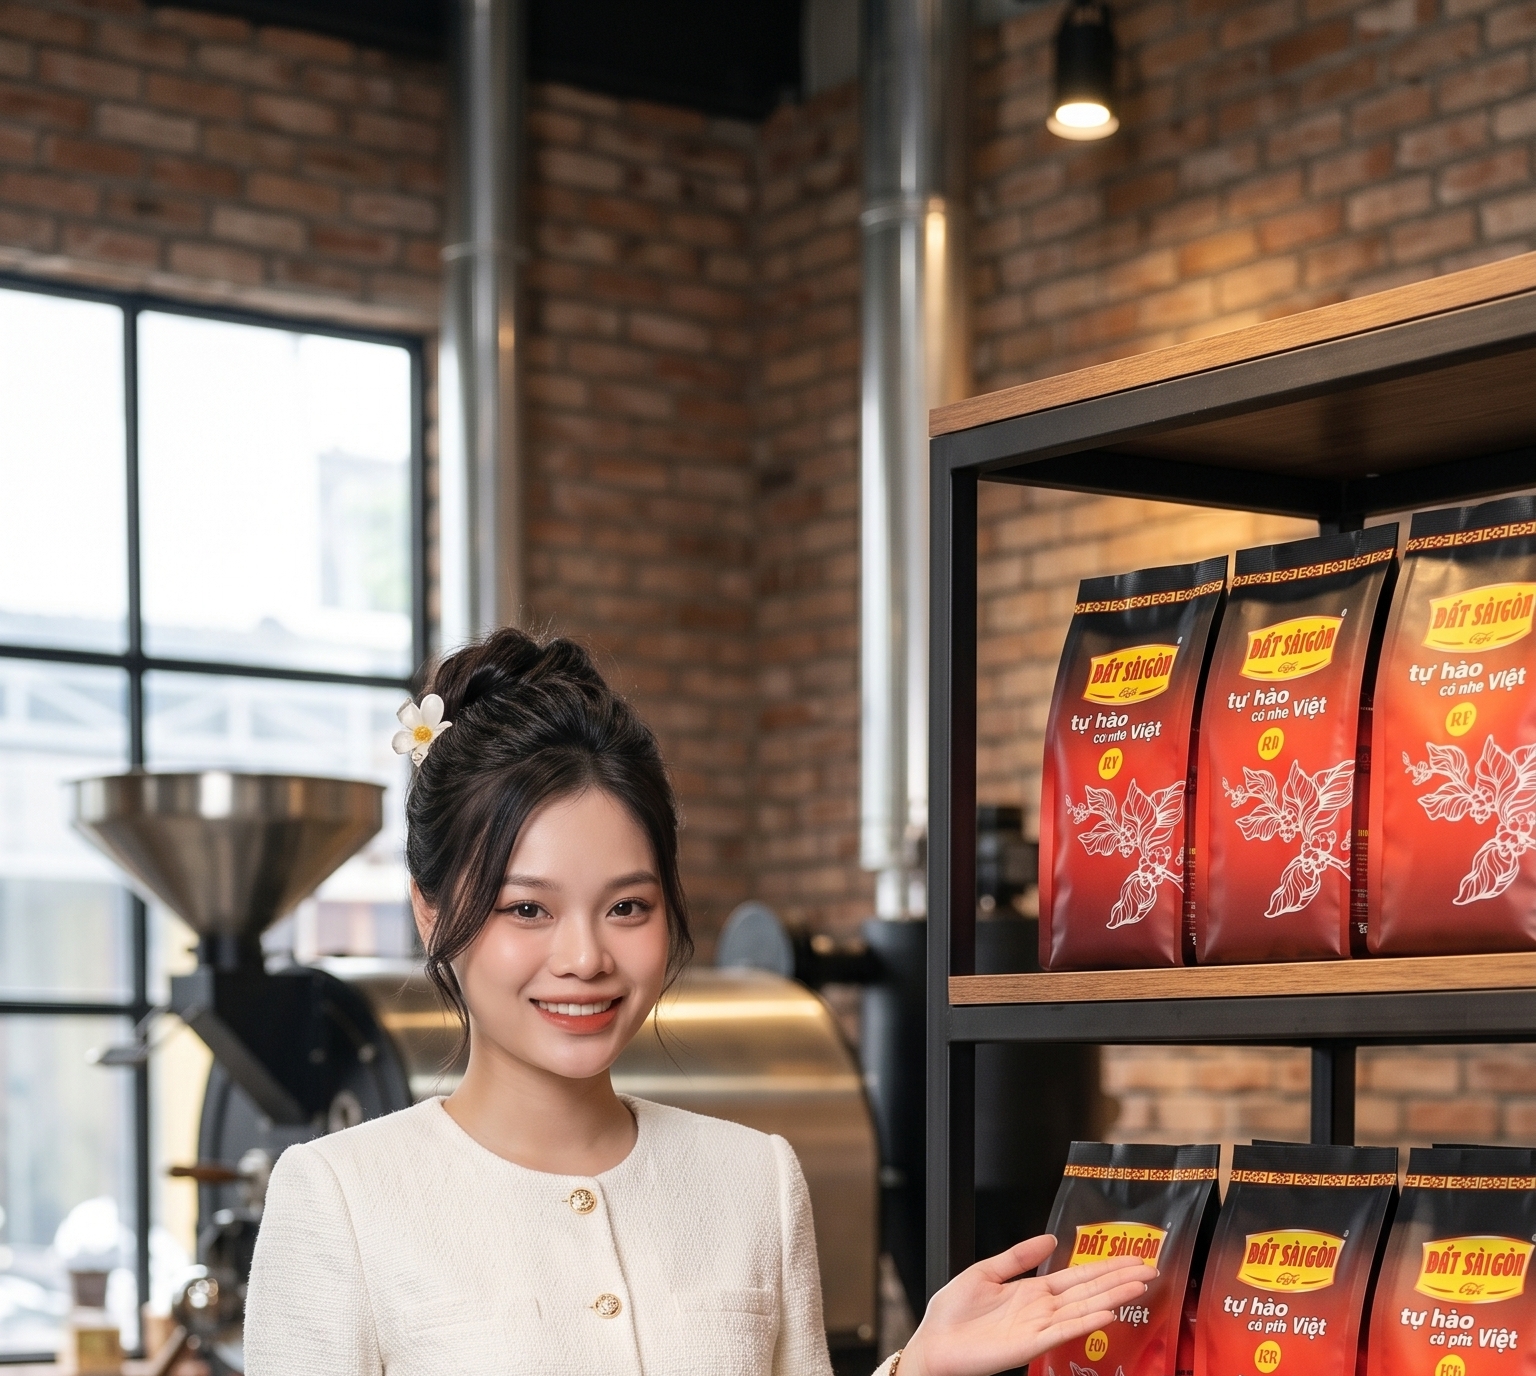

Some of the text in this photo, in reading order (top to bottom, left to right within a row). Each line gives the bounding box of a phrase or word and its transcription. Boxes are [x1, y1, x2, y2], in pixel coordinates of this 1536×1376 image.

[1410, 660, 1483, 685] tự hào
[1489, 667, 1526, 691] Việt
[1228, 688, 1289, 712] tự hào
[1293, 697, 1327, 719] Việt
[1071, 712, 1128, 734] tự hào
[1132, 721, 1162, 741] Việt
[1119, 1306, 1149, 1327] Việt
[1224, 1296, 1288, 1317] tự hào
[1293, 1317, 1326, 1339] Việt
[1401, 1308, 1474, 1330] tự hào
[1478, 1328, 1518, 1353] Việt
